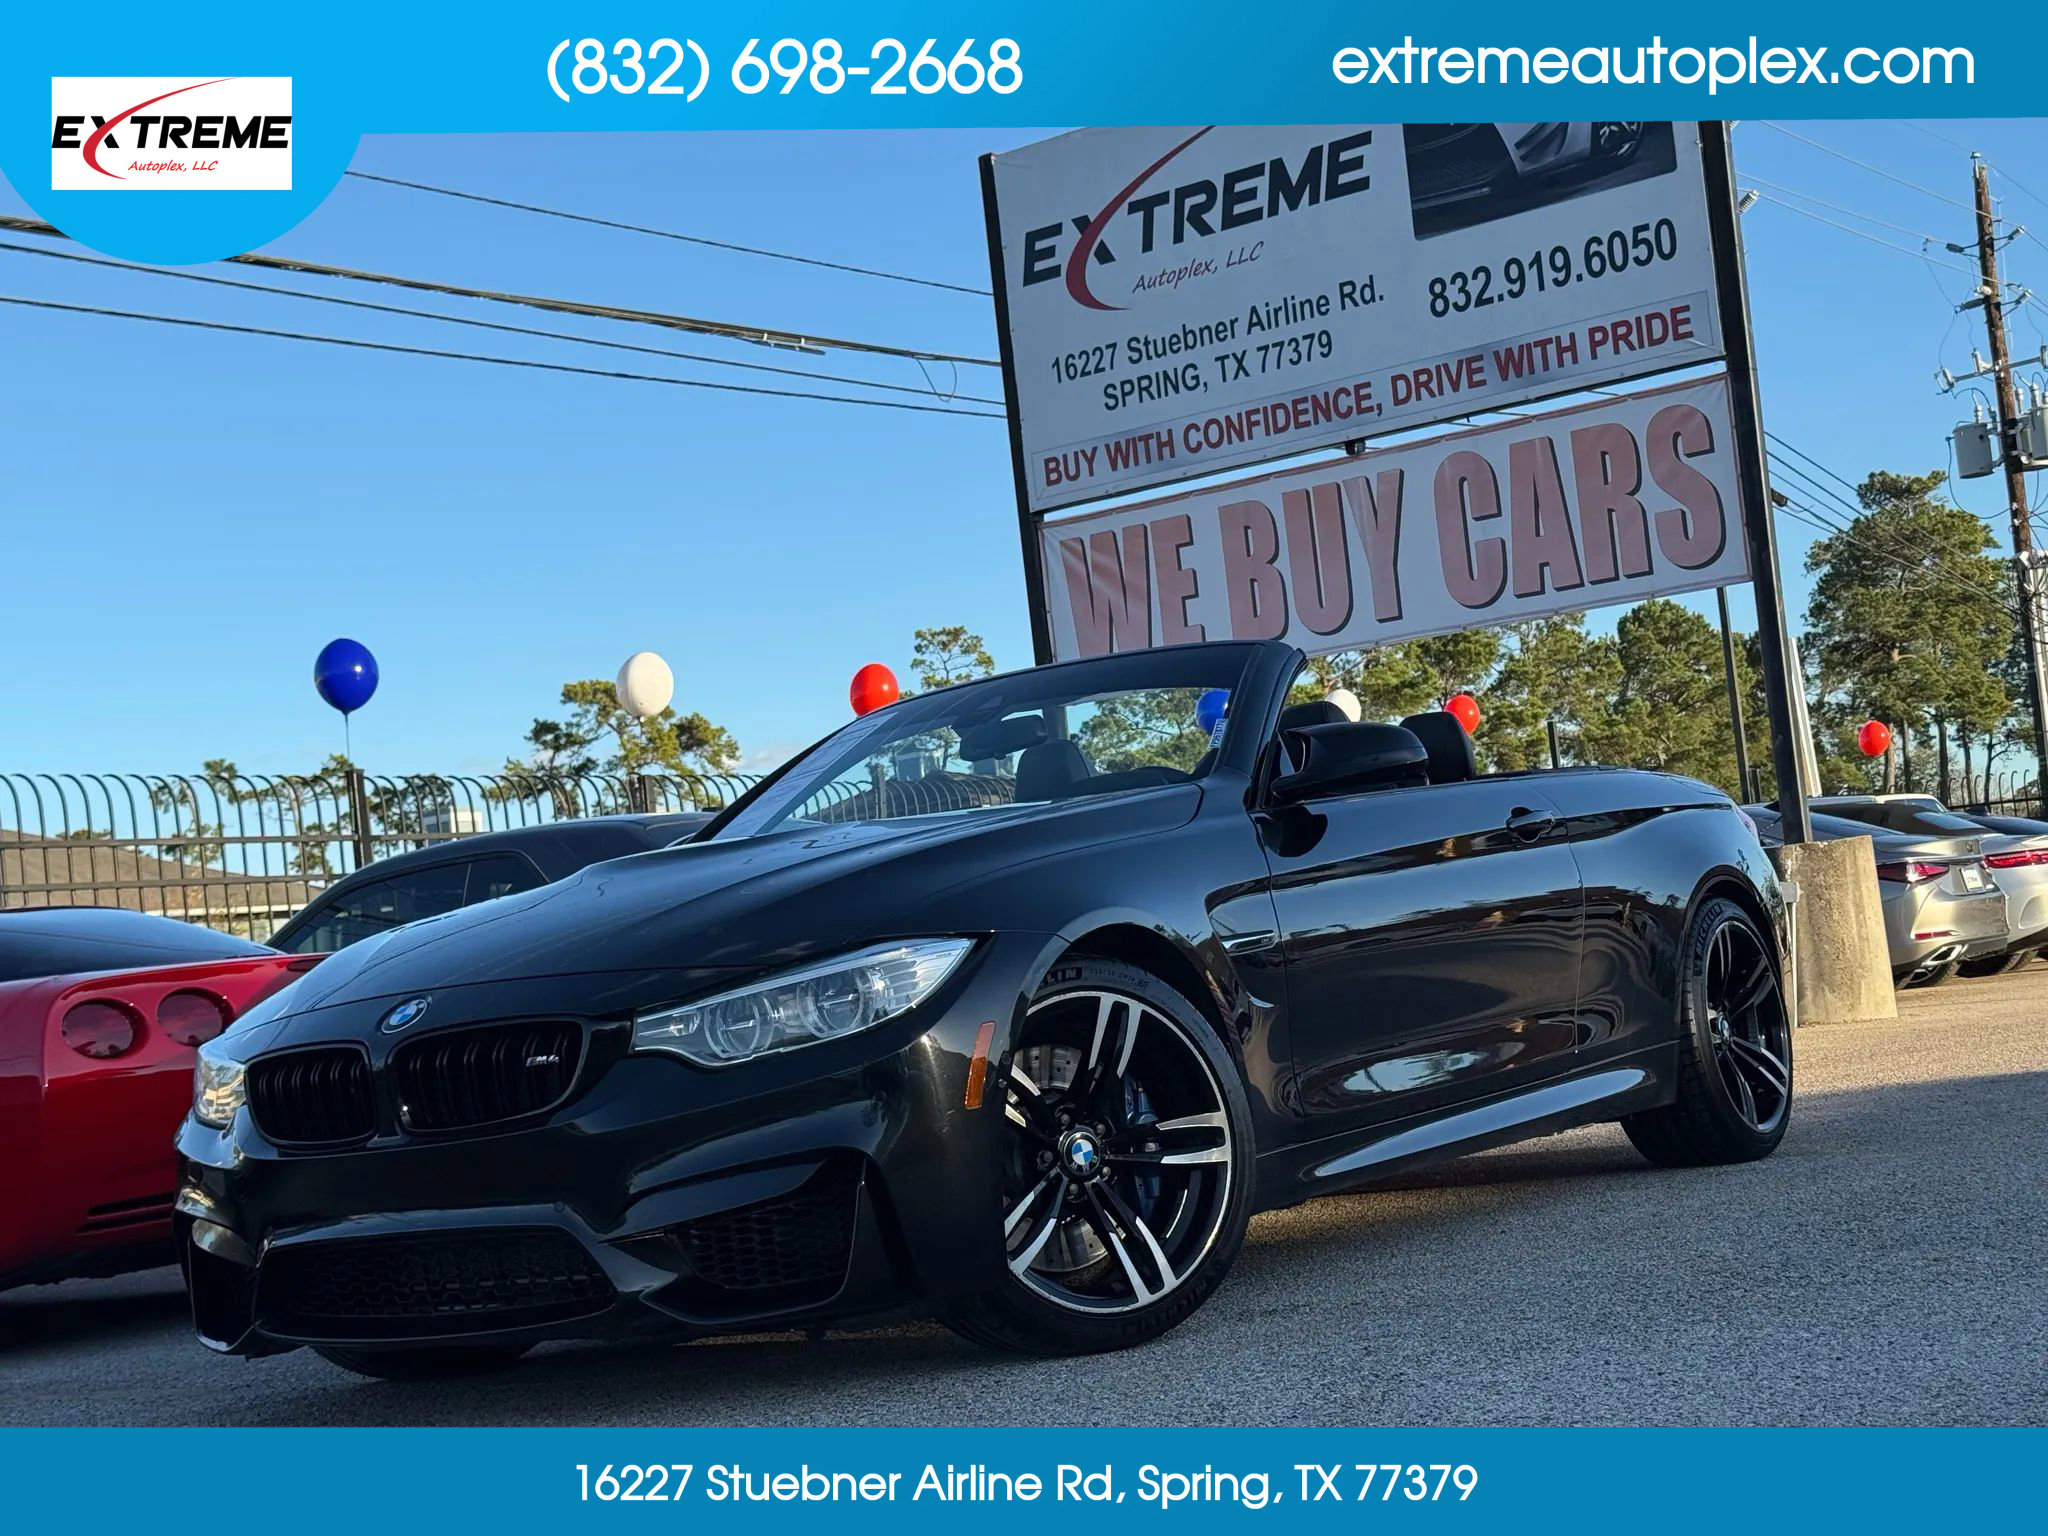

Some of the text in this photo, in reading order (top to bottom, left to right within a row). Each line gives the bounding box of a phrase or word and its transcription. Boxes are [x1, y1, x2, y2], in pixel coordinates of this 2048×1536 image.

[1022, 130, 1373, 288] EXTREME
[1132, 241, 1264, 293] Autoplex, LLC
[1428, 217, 1678, 319] 832.919.6050
[1051, 274, 1385, 383] 16227 Stuebner Airline Rd.
[1103, 329, 1333, 411] SPRING, TX 77379
[1043, 304, 1695, 487] BUY WITH CONFIDENCE, DRIVE WITH PRIDE
[1060, 404, 1727, 658] WE BUY CARS
